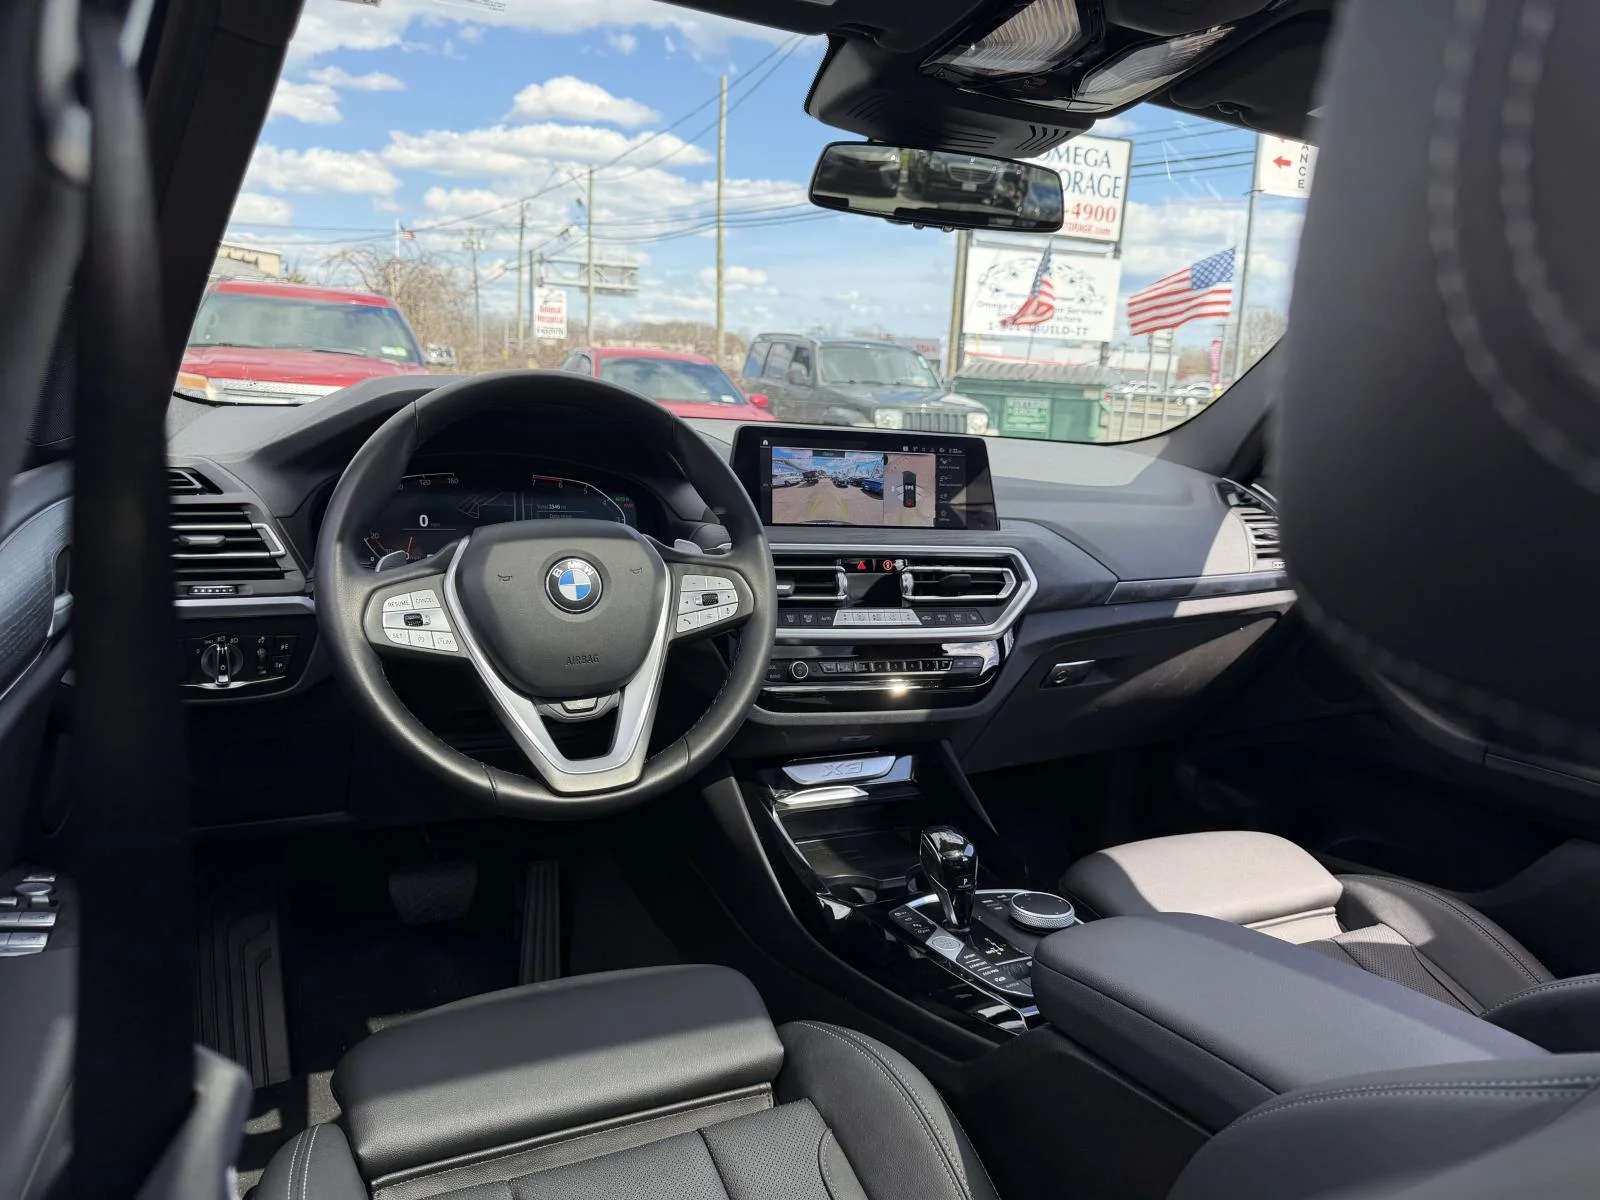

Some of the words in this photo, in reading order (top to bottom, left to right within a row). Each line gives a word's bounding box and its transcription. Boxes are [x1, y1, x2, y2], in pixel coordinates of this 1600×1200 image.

[1056, 168, 1122, 199] ORAGE
[447, 477, 459, 485] 160
[419, 514, 429, 528] 0
[552, 561, 594, 578] BMW
[387, 600, 410, 608] RESUME
[566, 654, 600, 666] AIRBAG
[823, 761, 864, 777] X3
[963, 878, 968, 886] P
